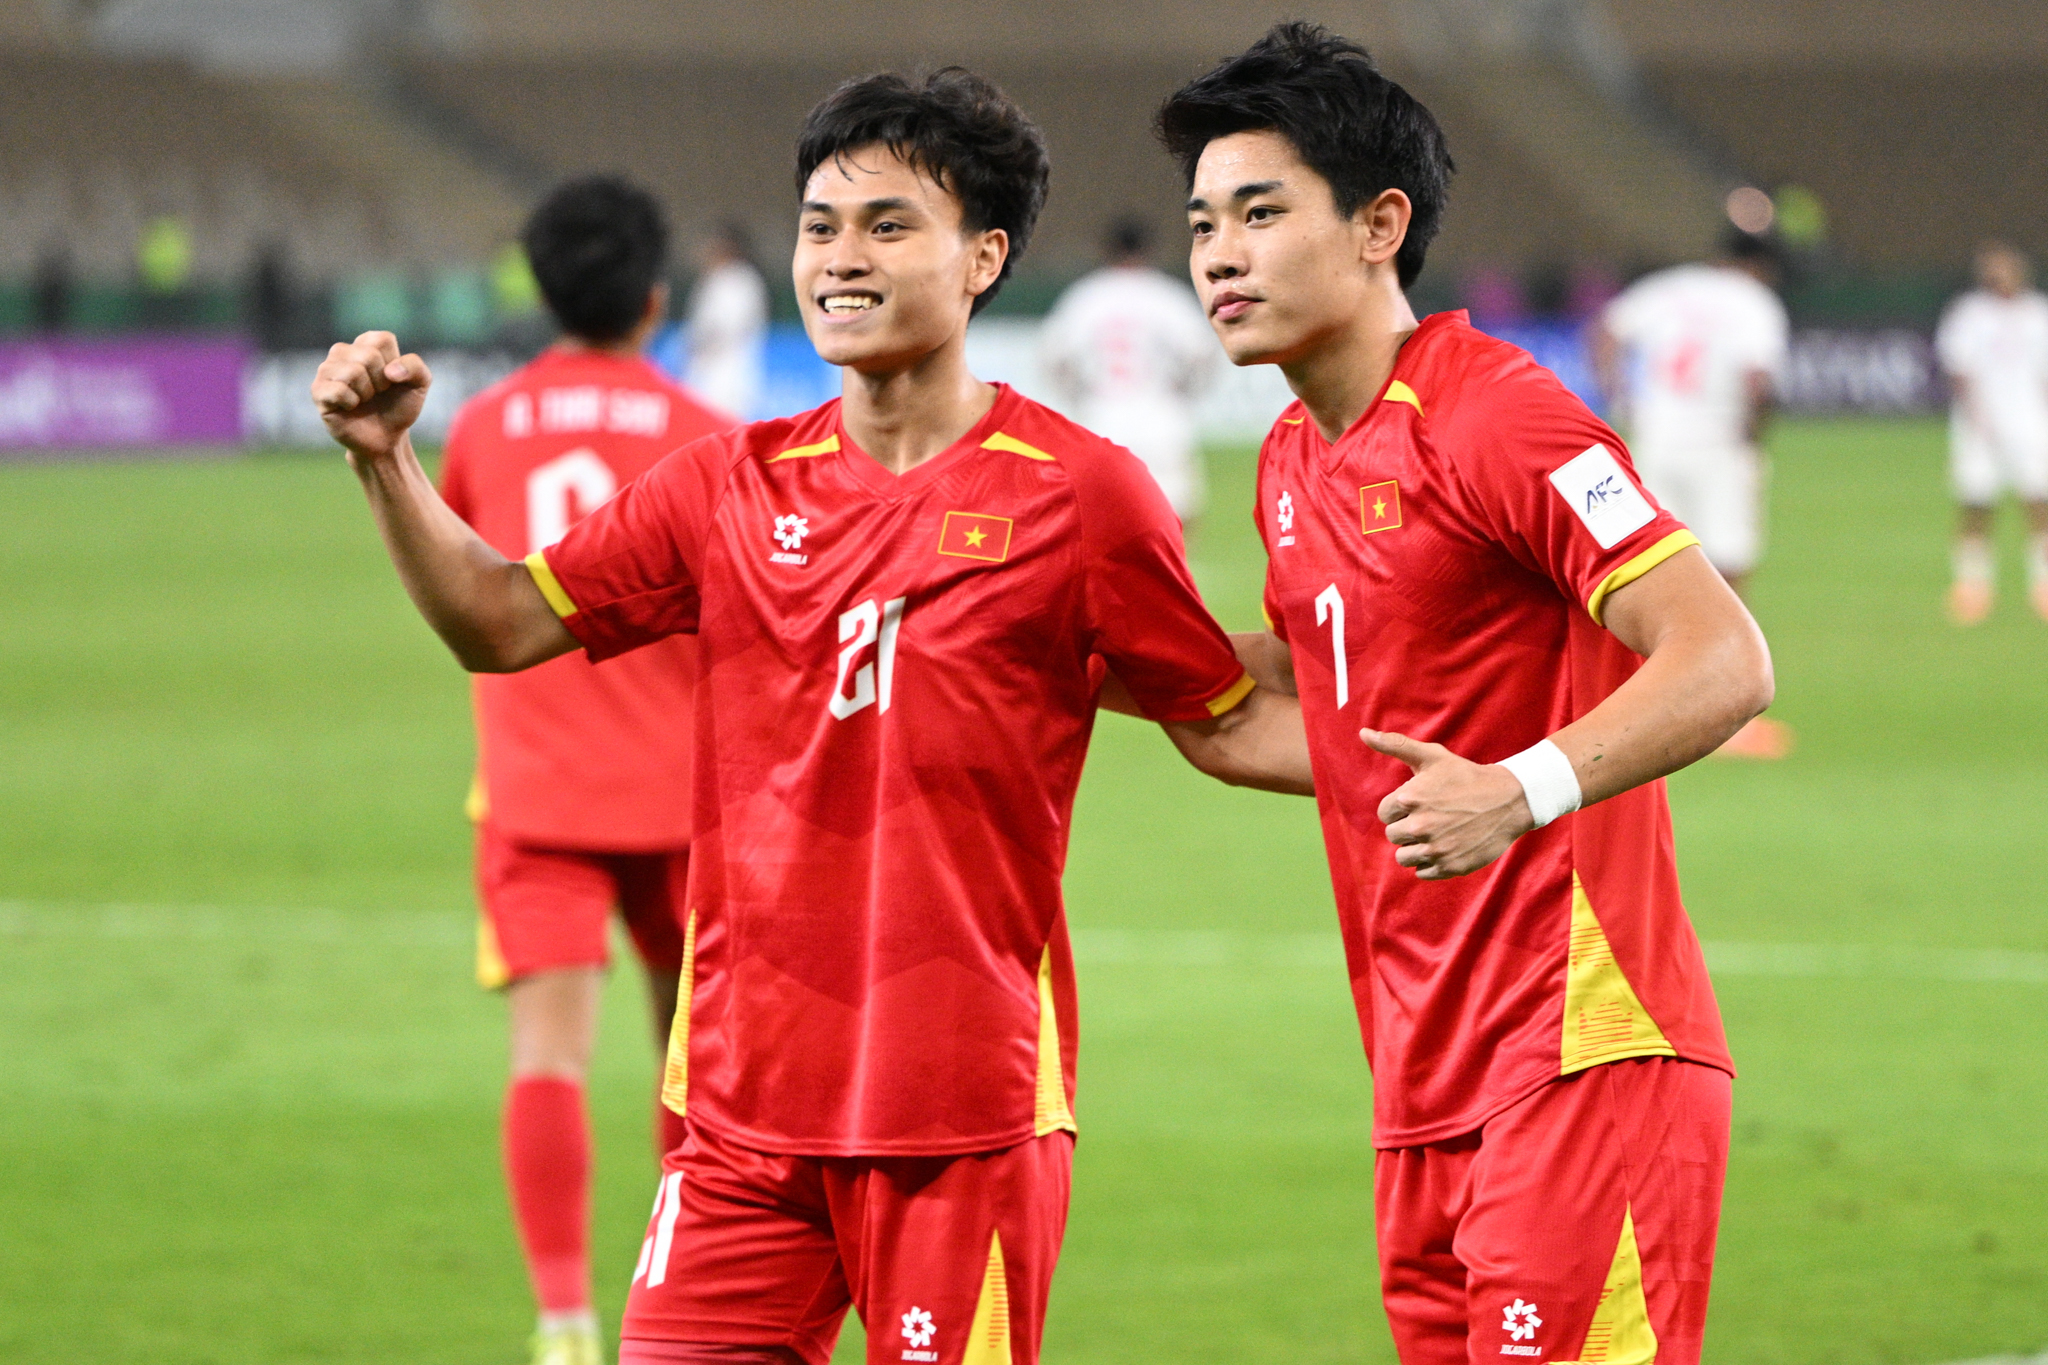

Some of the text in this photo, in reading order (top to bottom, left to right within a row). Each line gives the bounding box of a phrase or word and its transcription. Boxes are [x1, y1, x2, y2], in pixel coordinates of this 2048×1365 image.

[1586, 474, 1624, 515] AFC
[828, 596, 907, 722] 21
[1315, 583, 1349, 711] 7
